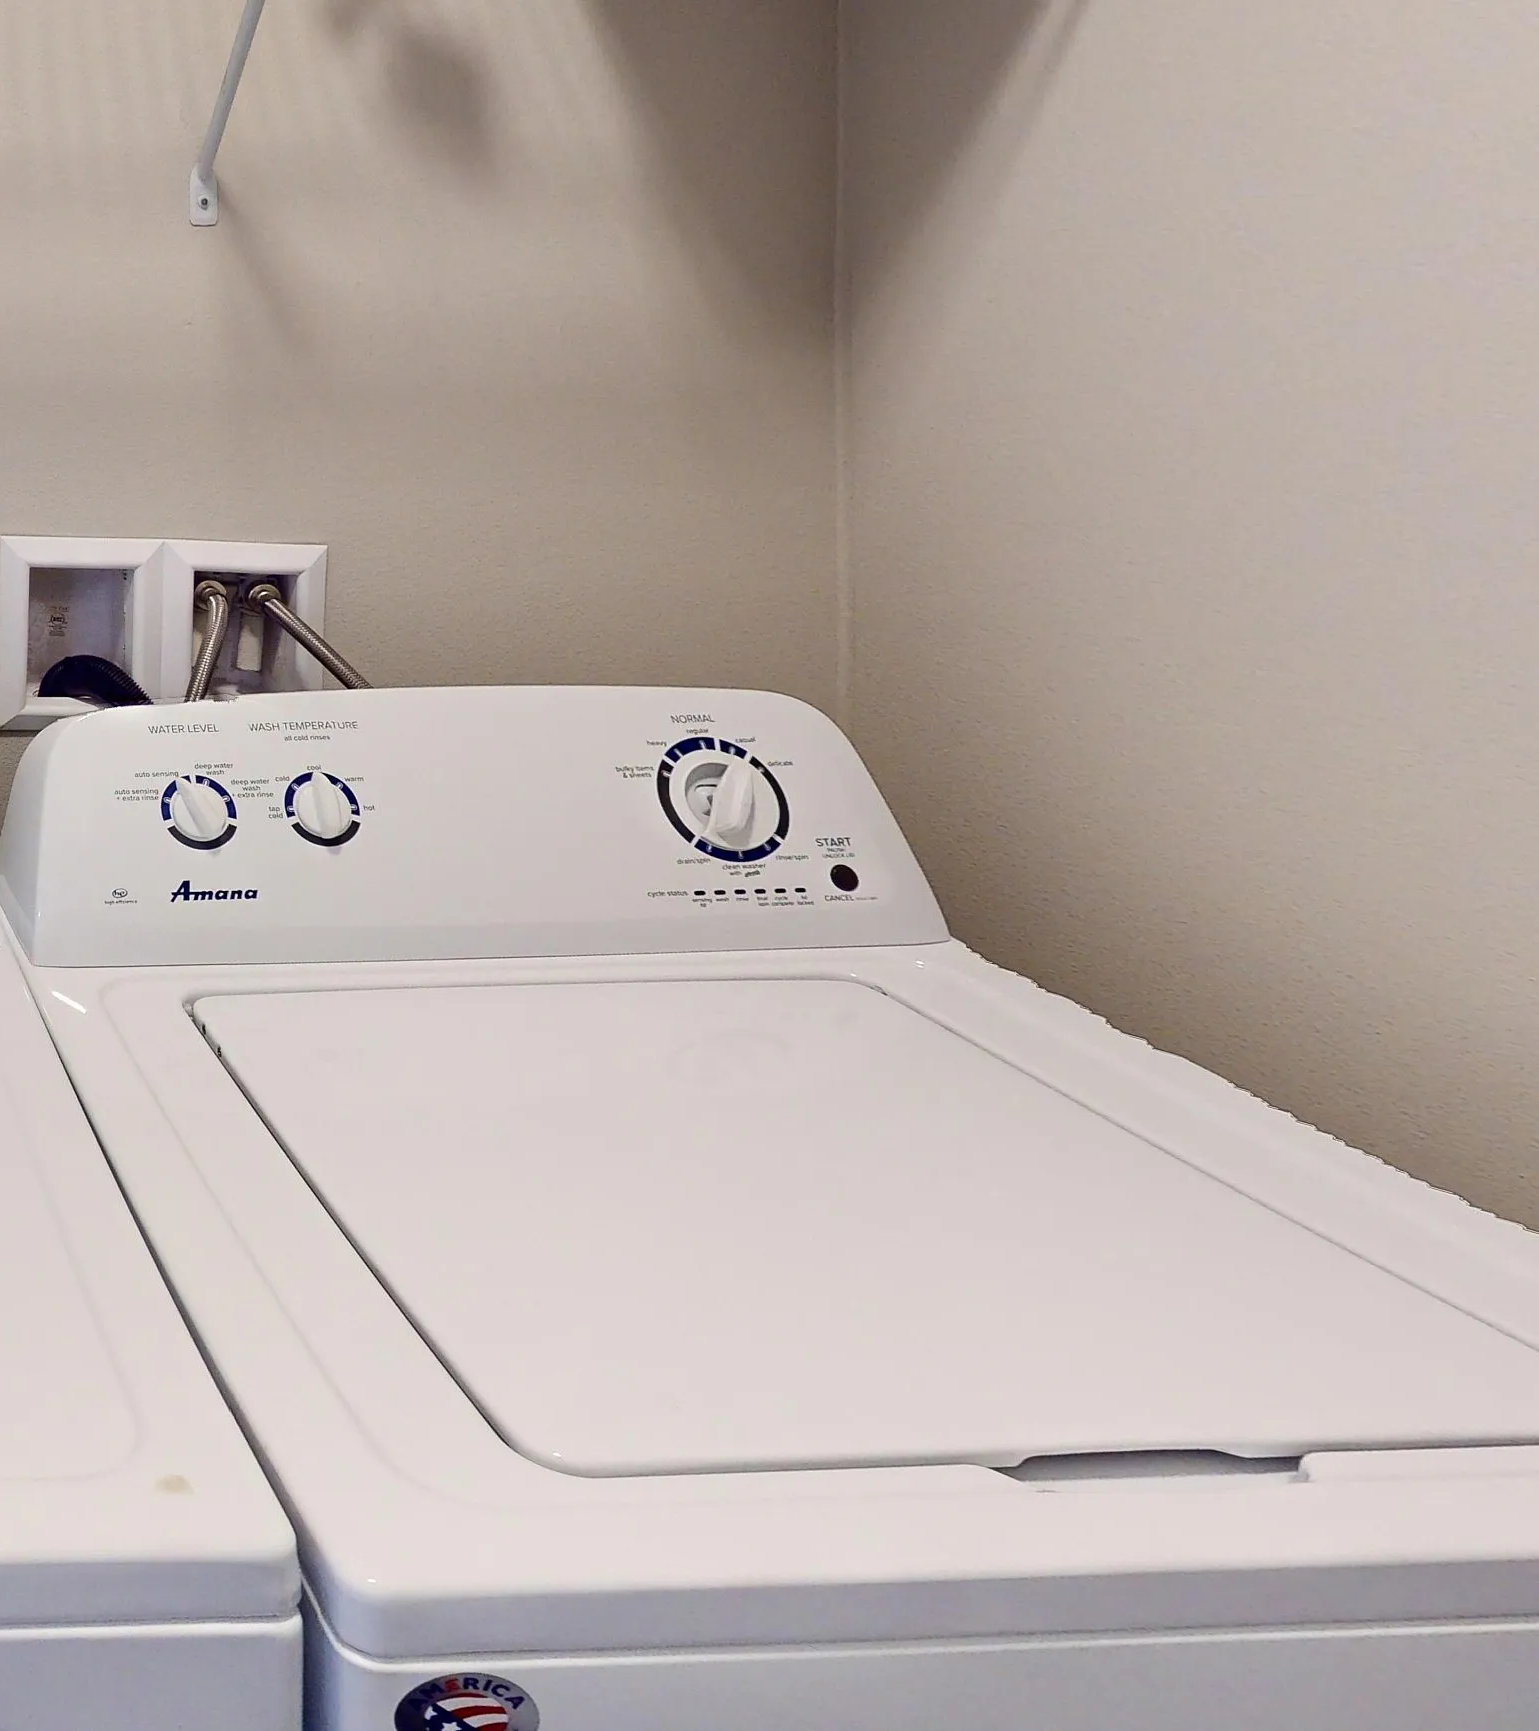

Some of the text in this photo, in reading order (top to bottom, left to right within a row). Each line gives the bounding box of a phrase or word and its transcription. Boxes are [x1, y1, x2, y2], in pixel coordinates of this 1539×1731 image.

[670, 714, 716, 724] NORMAL
[148, 724, 219, 734] WATER LEVEL
[248, 721, 359, 732] WASH TEMPERATURE
[194, 762, 212, 770] deep
[132, 788, 159, 796] sensing
[815, 837, 852, 847] START
[170, 880, 258, 903] Amana
[408, 1677, 526, 1712] AMERICA
